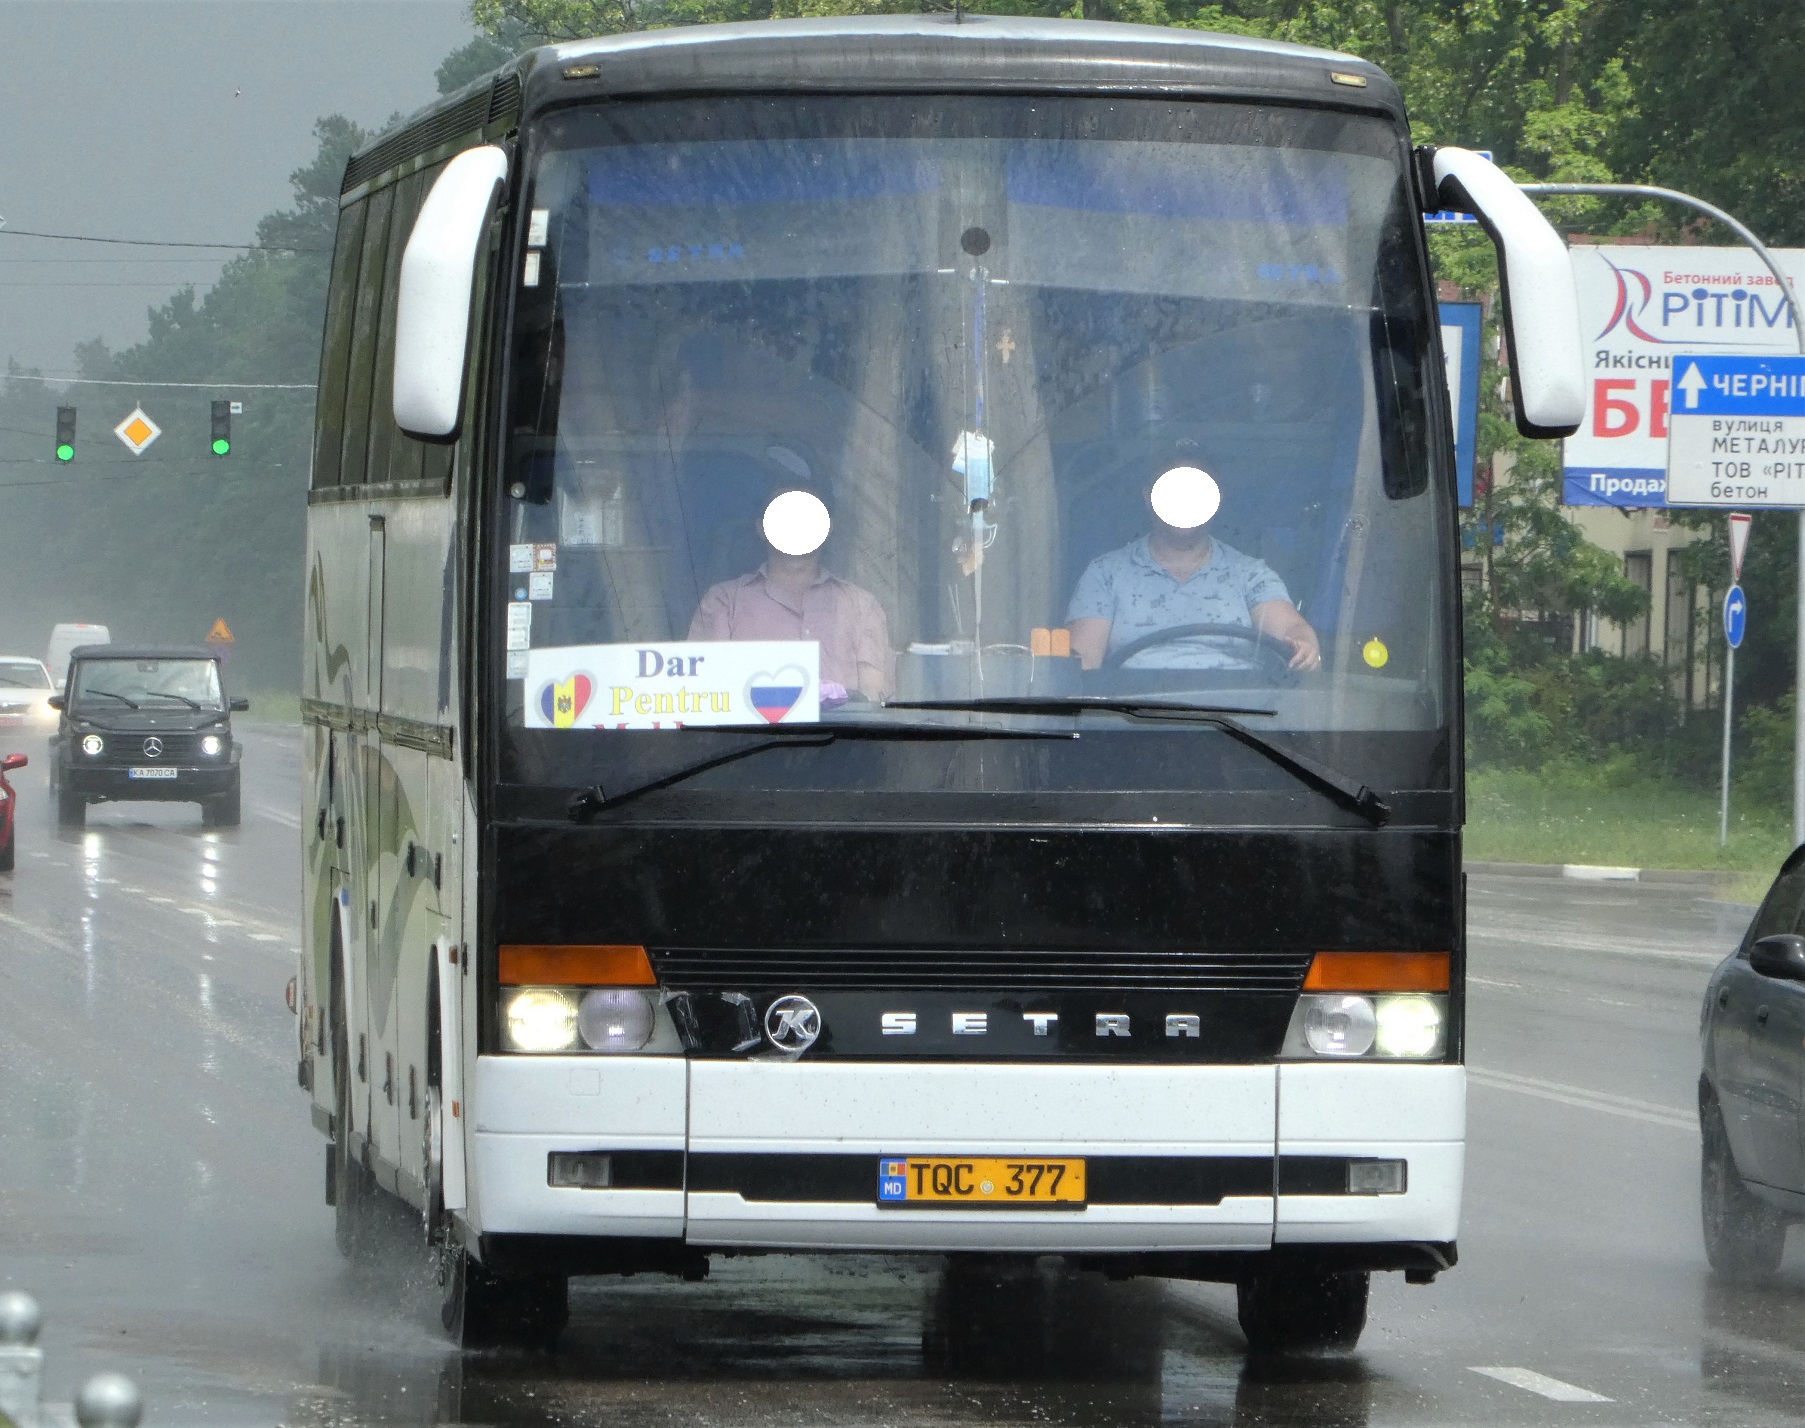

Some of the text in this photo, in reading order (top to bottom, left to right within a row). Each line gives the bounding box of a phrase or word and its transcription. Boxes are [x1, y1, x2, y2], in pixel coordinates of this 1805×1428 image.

[1663, 271, 1742, 285] Бетонний
[1712, 420, 1784, 436] вулиця
[1711, 461, 1752, 479] ТОВ
[1710, 481, 1768, 499] бетон
[634, 649, 705, 679] Dar
[608, 686, 731, 716] Pentru
[881, 1012, 1201, 1037] SETRA
[884, 1163, 1067, 1196] MD TQC 377
